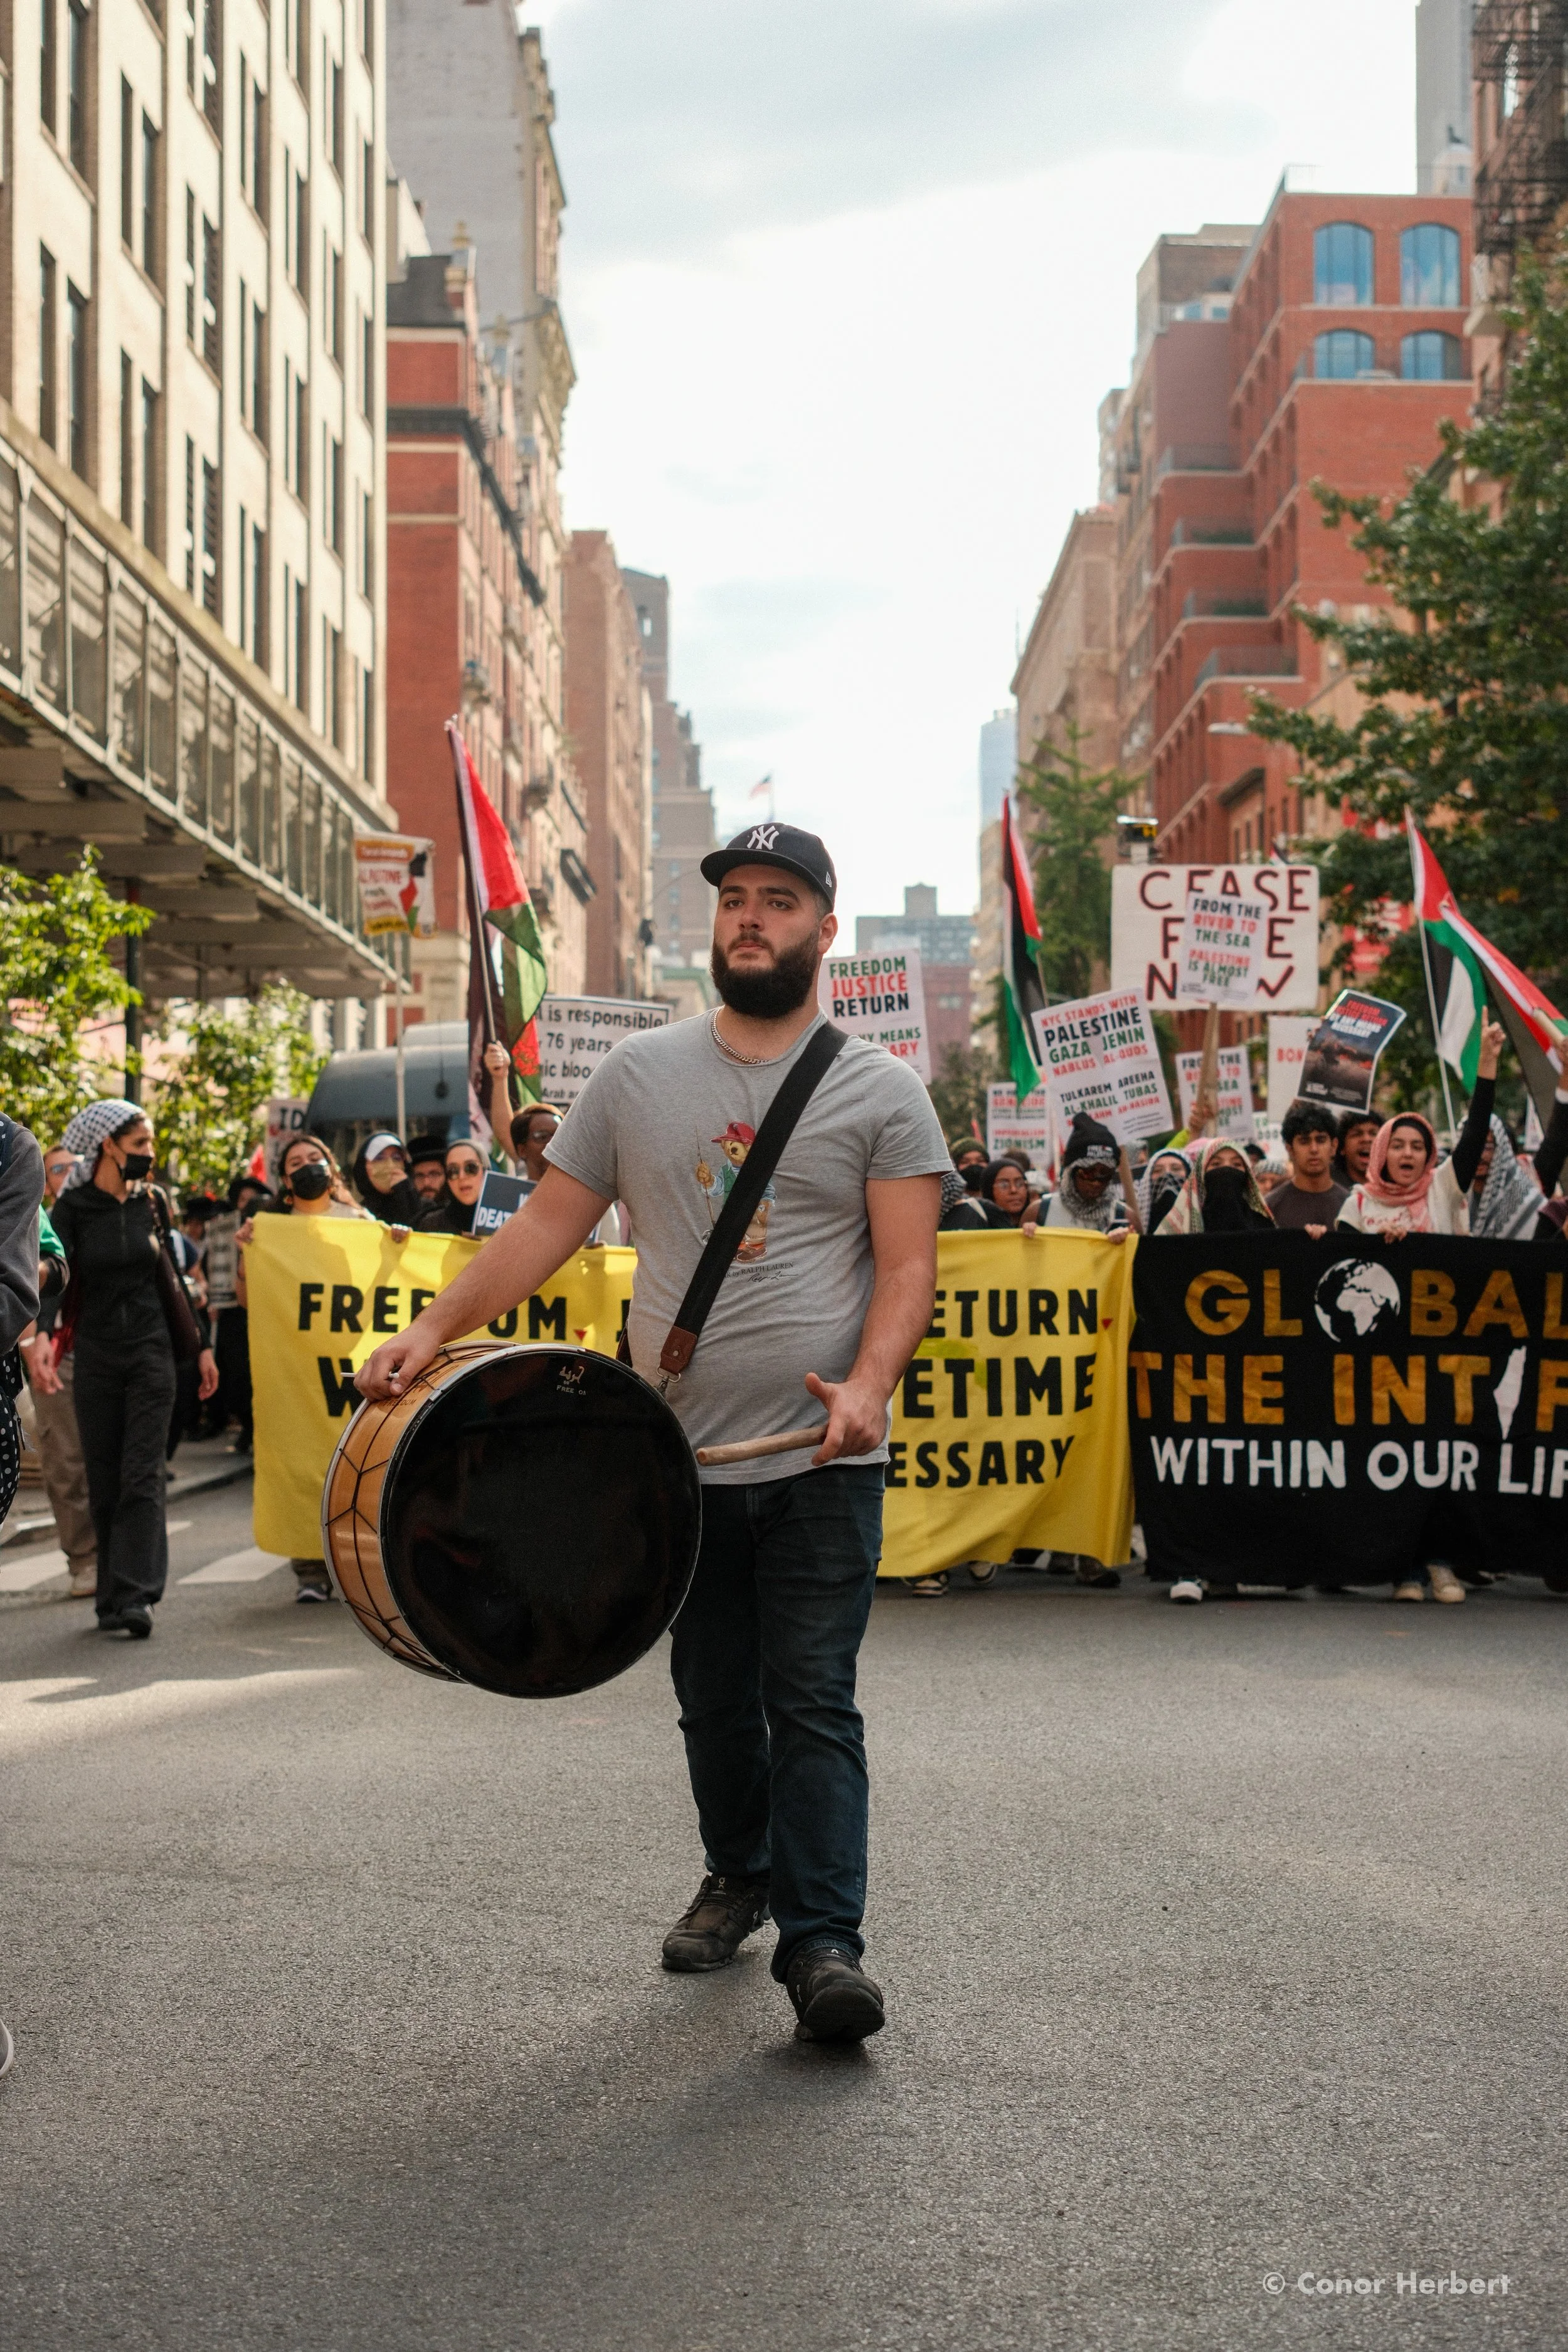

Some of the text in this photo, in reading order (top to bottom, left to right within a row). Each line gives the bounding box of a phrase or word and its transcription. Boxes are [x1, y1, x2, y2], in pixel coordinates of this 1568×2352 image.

[746, 825, 780, 850] NY
[1139, 868, 1312, 912] CEASE
[1193, 898, 1262, 920] FROM THE
[1193, 913, 1257, 934] RIVER TO
[1160, 916, 1295, 959] FE
[1195, 928, 1251, 948] THE SEA
[829, 956, 906, 978] FREEDOM
[1188, 960, 1248, 978] IS ALMOST
[1189, 948, 1251, 969] PALESTINE
[832, 972, 907, 998] JUSTICE
[1145, 961, 1295, 1002] NW
[548, 1005, 562, 1022] is
[568, 1008, 663, 1029] responsible
[833, 993, 909, 1017] RETURN
[1041, 995, 1137, 1028] NYC STANDS WITH
[880, 1027, 921, 1042] MEANS
[1044, 1007, 1142, 1047] PALESTINE
[547, 1032, 564, 1049] 76
[571, 1036, 612, 1054] years
[889, 1041, 918, 1057] ARY
[1049, 1026, 1145, 1063] GAZA JENIN
[562, 1061, 592, 1079] bloo
[1053, 1057, 1096, 1077] NABLUS
[1060, 1070, 1155, 1103] TULKAREM AREEHA
[1123, 1083, 1158, 1101] TUBAS
[280, 1108, 305, 1130] ID
[477, 1206, 512, 1228] DEAT
[741, 1266, 765, 1275] RALPH
[766, 1262, 793, 1271] LAUREN
[298, 1283, 566, 1340] FREEOM
[925, 1289, 1098, 1337] ETURN
[903, 1353, 1096, 1418] ETIME
[1130, 1352, 1284, 1424] THE
[885, 1435, 1074, 1489] ESSARY
[1150, 1436, 1347, 1489] WITHIN
[1367, 1441, 1479, 1491] OUR
